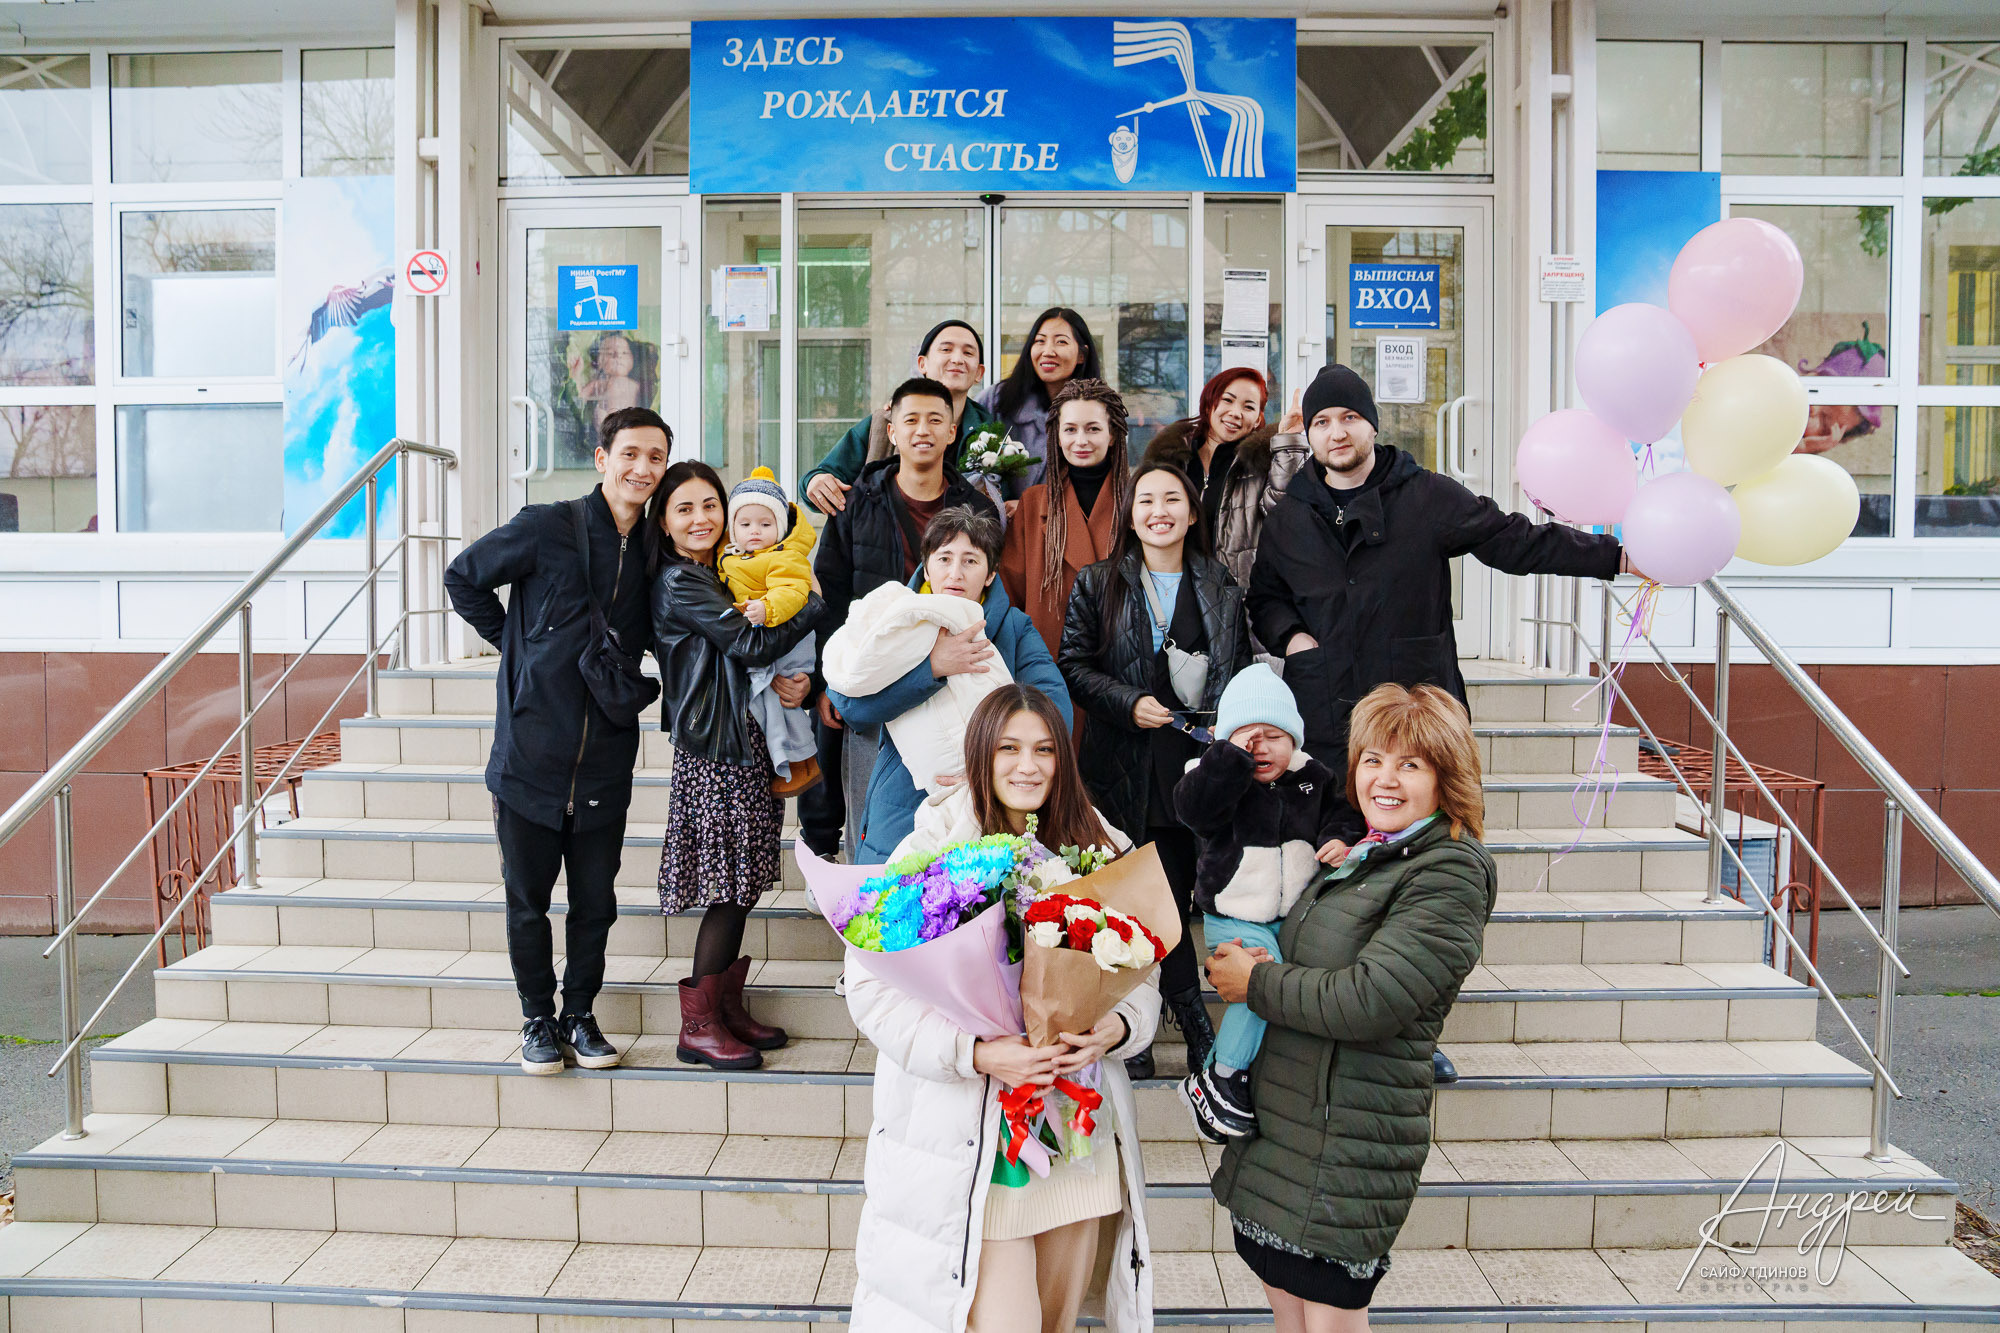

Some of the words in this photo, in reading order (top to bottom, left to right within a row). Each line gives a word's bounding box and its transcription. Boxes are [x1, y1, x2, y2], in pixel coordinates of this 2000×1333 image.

[722, 37, 844, 72] ЗДЕСЬ
[760, 89, 1008, 125] РОЖДАЕТСЯ
[884, 142, 1060, 173] СЧАСТЬЕ
[1354, 270, 1434, 282] ВЫПИСНАЯ
[1356, 288, 1431, 314] ВХОД
[1385, 344, 1414, 355] ВХОД
[1191, 1087, 1214, 1126] FILA
